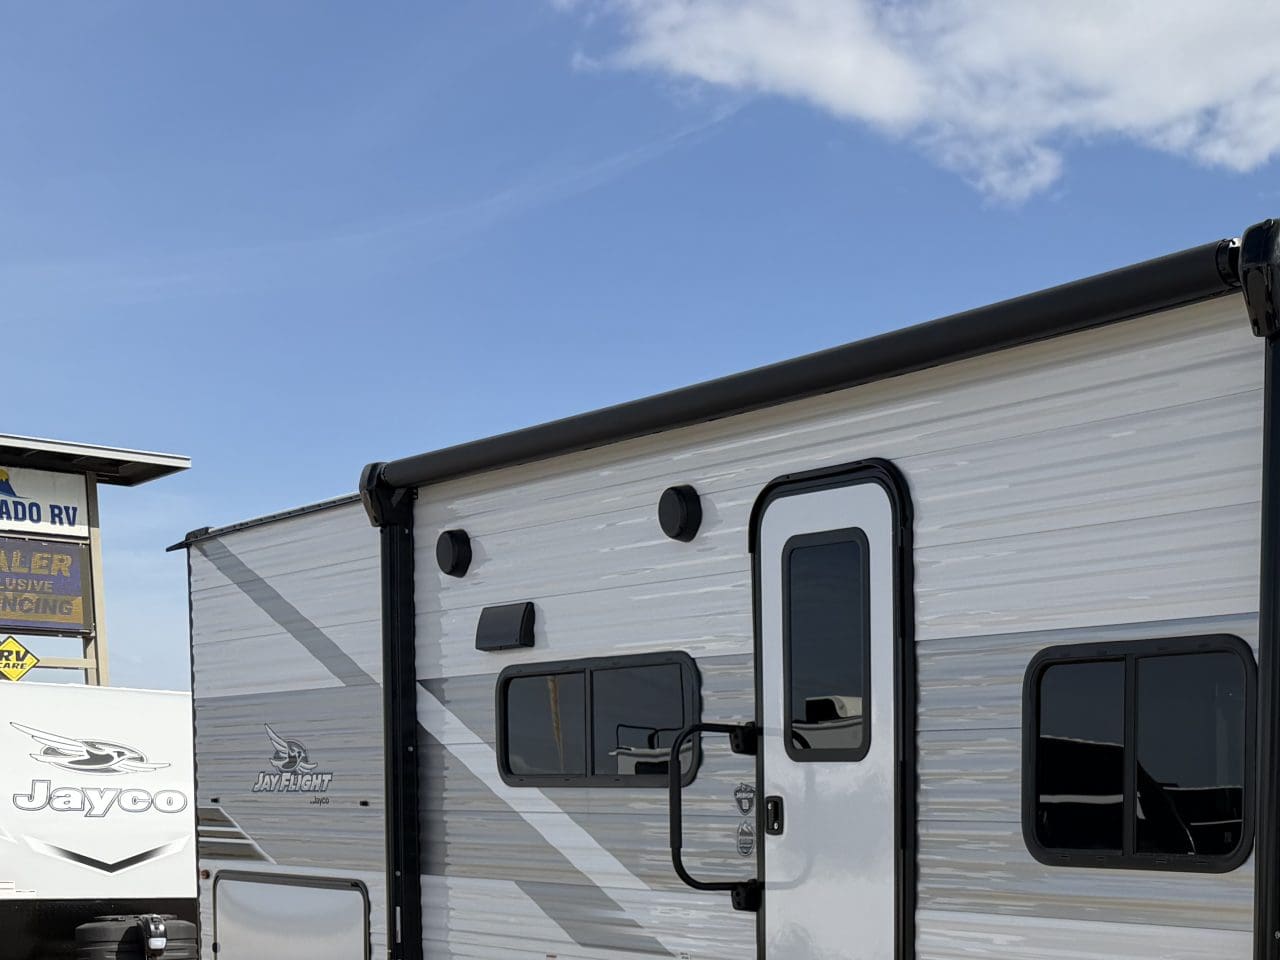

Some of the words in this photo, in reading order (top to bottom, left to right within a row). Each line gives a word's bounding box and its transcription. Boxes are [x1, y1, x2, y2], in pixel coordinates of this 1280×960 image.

[0, 499, 41, 524] ADO
[49, 504, 78, 527] RV
[0, 649, 28, 662] RV
[252, 771, 280, 792] JAY
[279, 772, 333, 792] FLIGHT
[13, 779, 188, 817] Jayco
